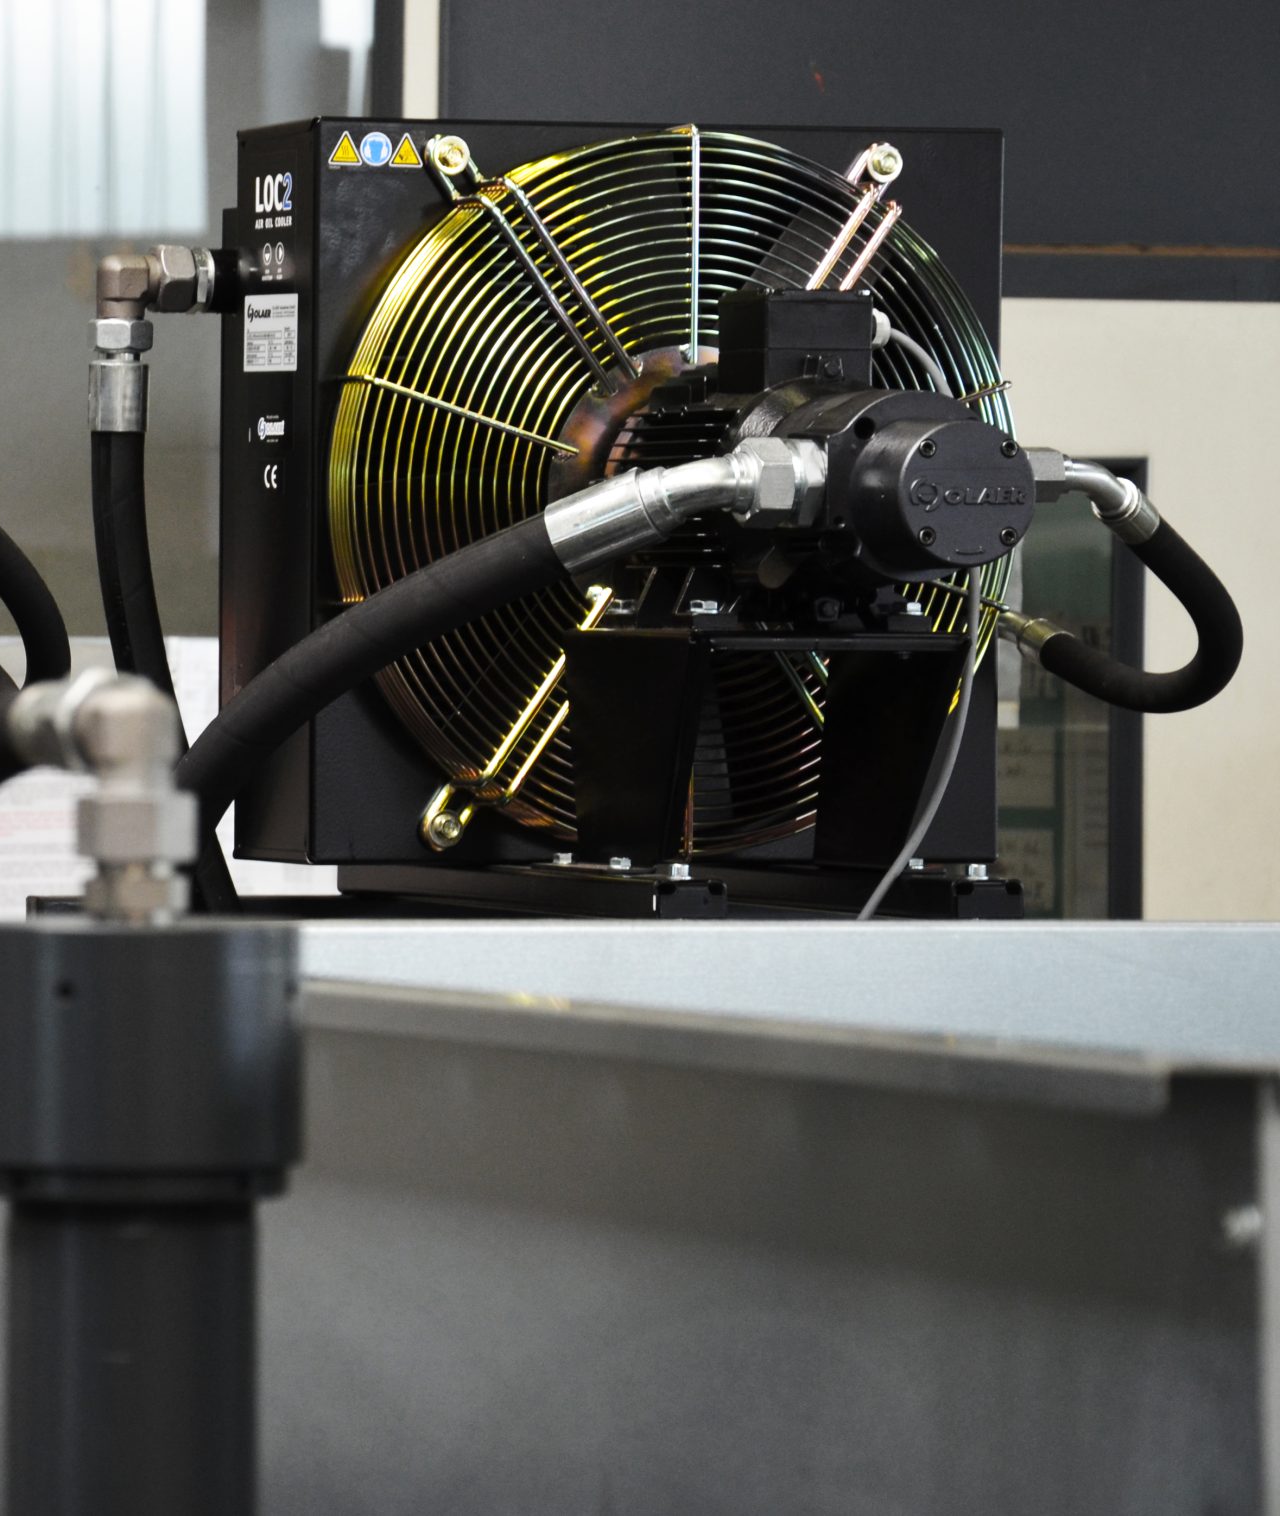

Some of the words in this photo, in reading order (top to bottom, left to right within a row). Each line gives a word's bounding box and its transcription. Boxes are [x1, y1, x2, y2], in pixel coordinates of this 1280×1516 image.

[255, 172, 293, 213] LOC2
[255, 219, 264, 230] AIR
[265, 218, 273, 229] OIL
[274, 216, 293, 228] COOLER
[943, 487, 1027, 506] OLAER
